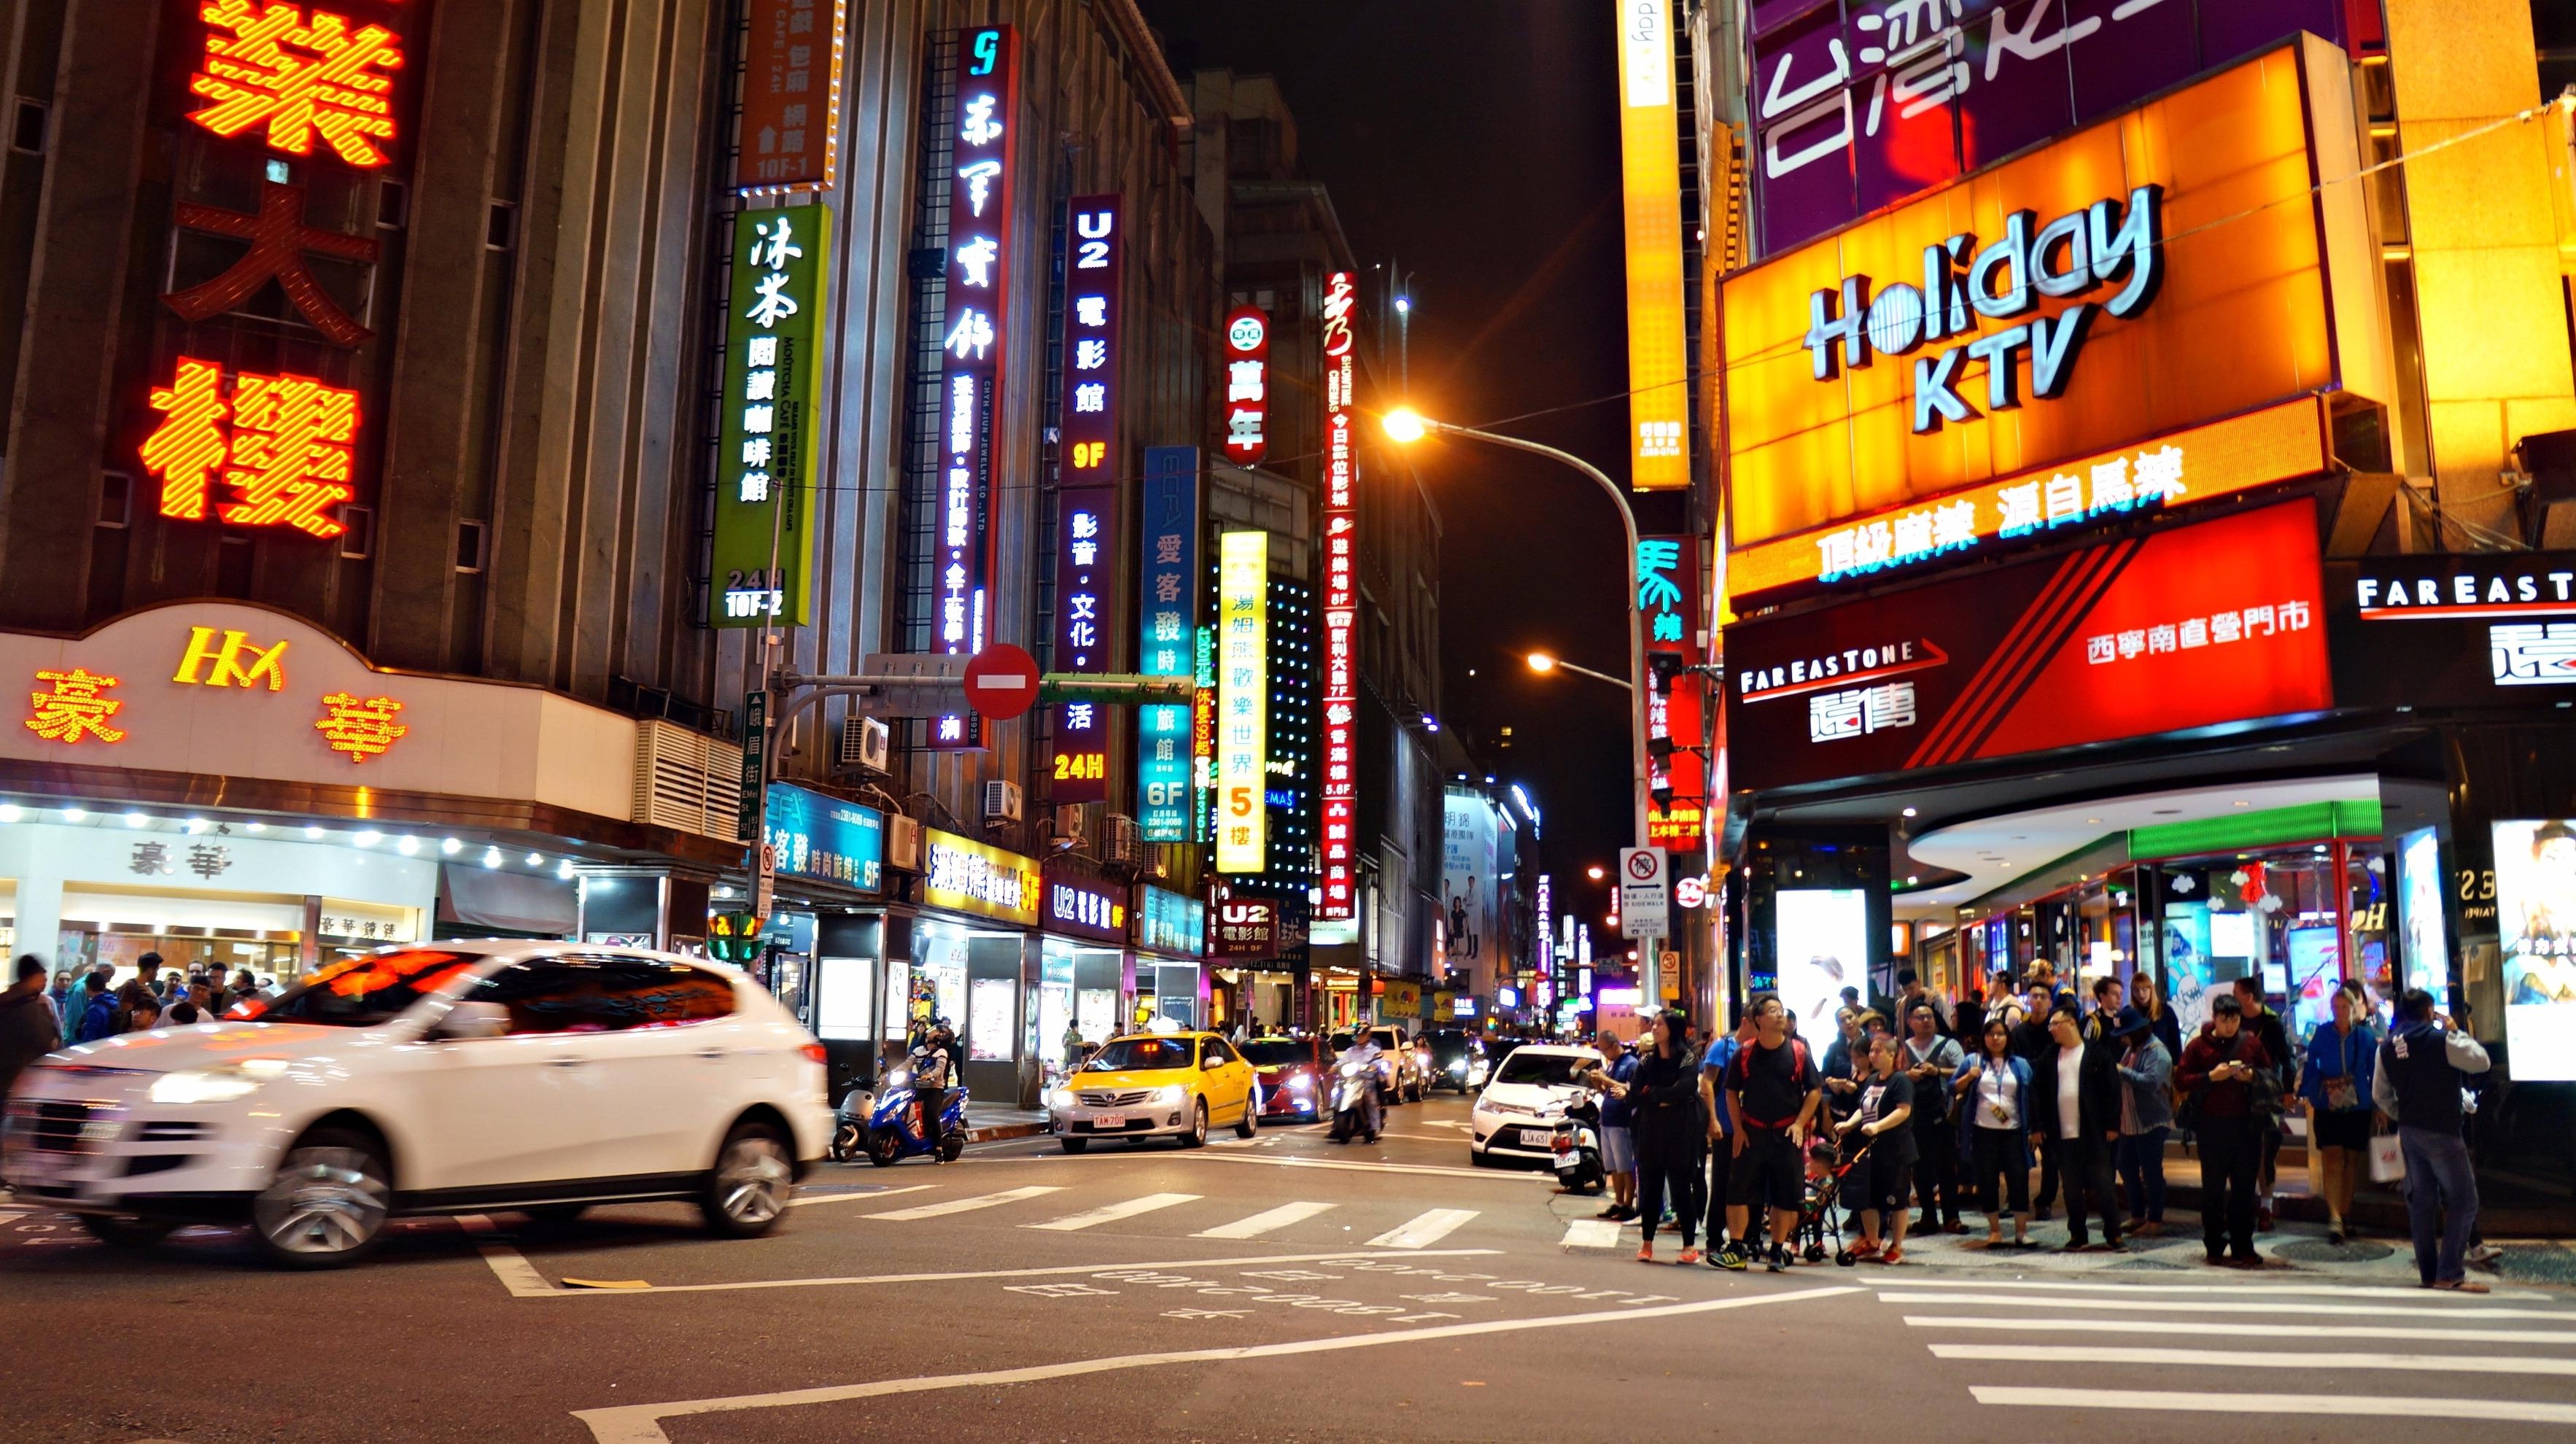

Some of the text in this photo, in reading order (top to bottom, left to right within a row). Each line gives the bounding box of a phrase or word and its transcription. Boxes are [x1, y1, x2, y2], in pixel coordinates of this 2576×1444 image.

[1802, 183, 2164, 382] Holiday
[1074, 296, 1106, 413] 電影館
[1912, 303, 2103, 435] KTV
[1328, 370, 1339, 413] CINEMAS
[1341, 355, 1351, 405] SHOWTIME
[1228, 360, 1263, 451] 萬年
[1074, 442, 1105, 467] 9F
[1817, 445, 2187, 581] 頂級麻辣 源自馬辣
[728, 569, 785, 591] 24H
[1331, 593, 1348, 605] 8F
[725, 594, 783, 618] 10F-2
[2087, 601, 2310, 665] 西寧南直營門市
[1231, 594, 1254, 774] 湯姆熊歡樂世界
[1330, 686, 1348, 696] 7F
[745, 708, 761, 783] 峨眉街
[1055, 753, 1103, 780] 24H
[766, 792, 803, 826] CFA
[1147, 781, 1183, 805] 6F
[128, 841, 233, 881] 豪華
[864, 859, 879, 887] 6F
[1020, 870, 1040, 912] 5F
[1053, 884, 1075, 920] U2
[1222, 904, 1270, 923] U2
[1222, 926, 1269, 942] 電影館
